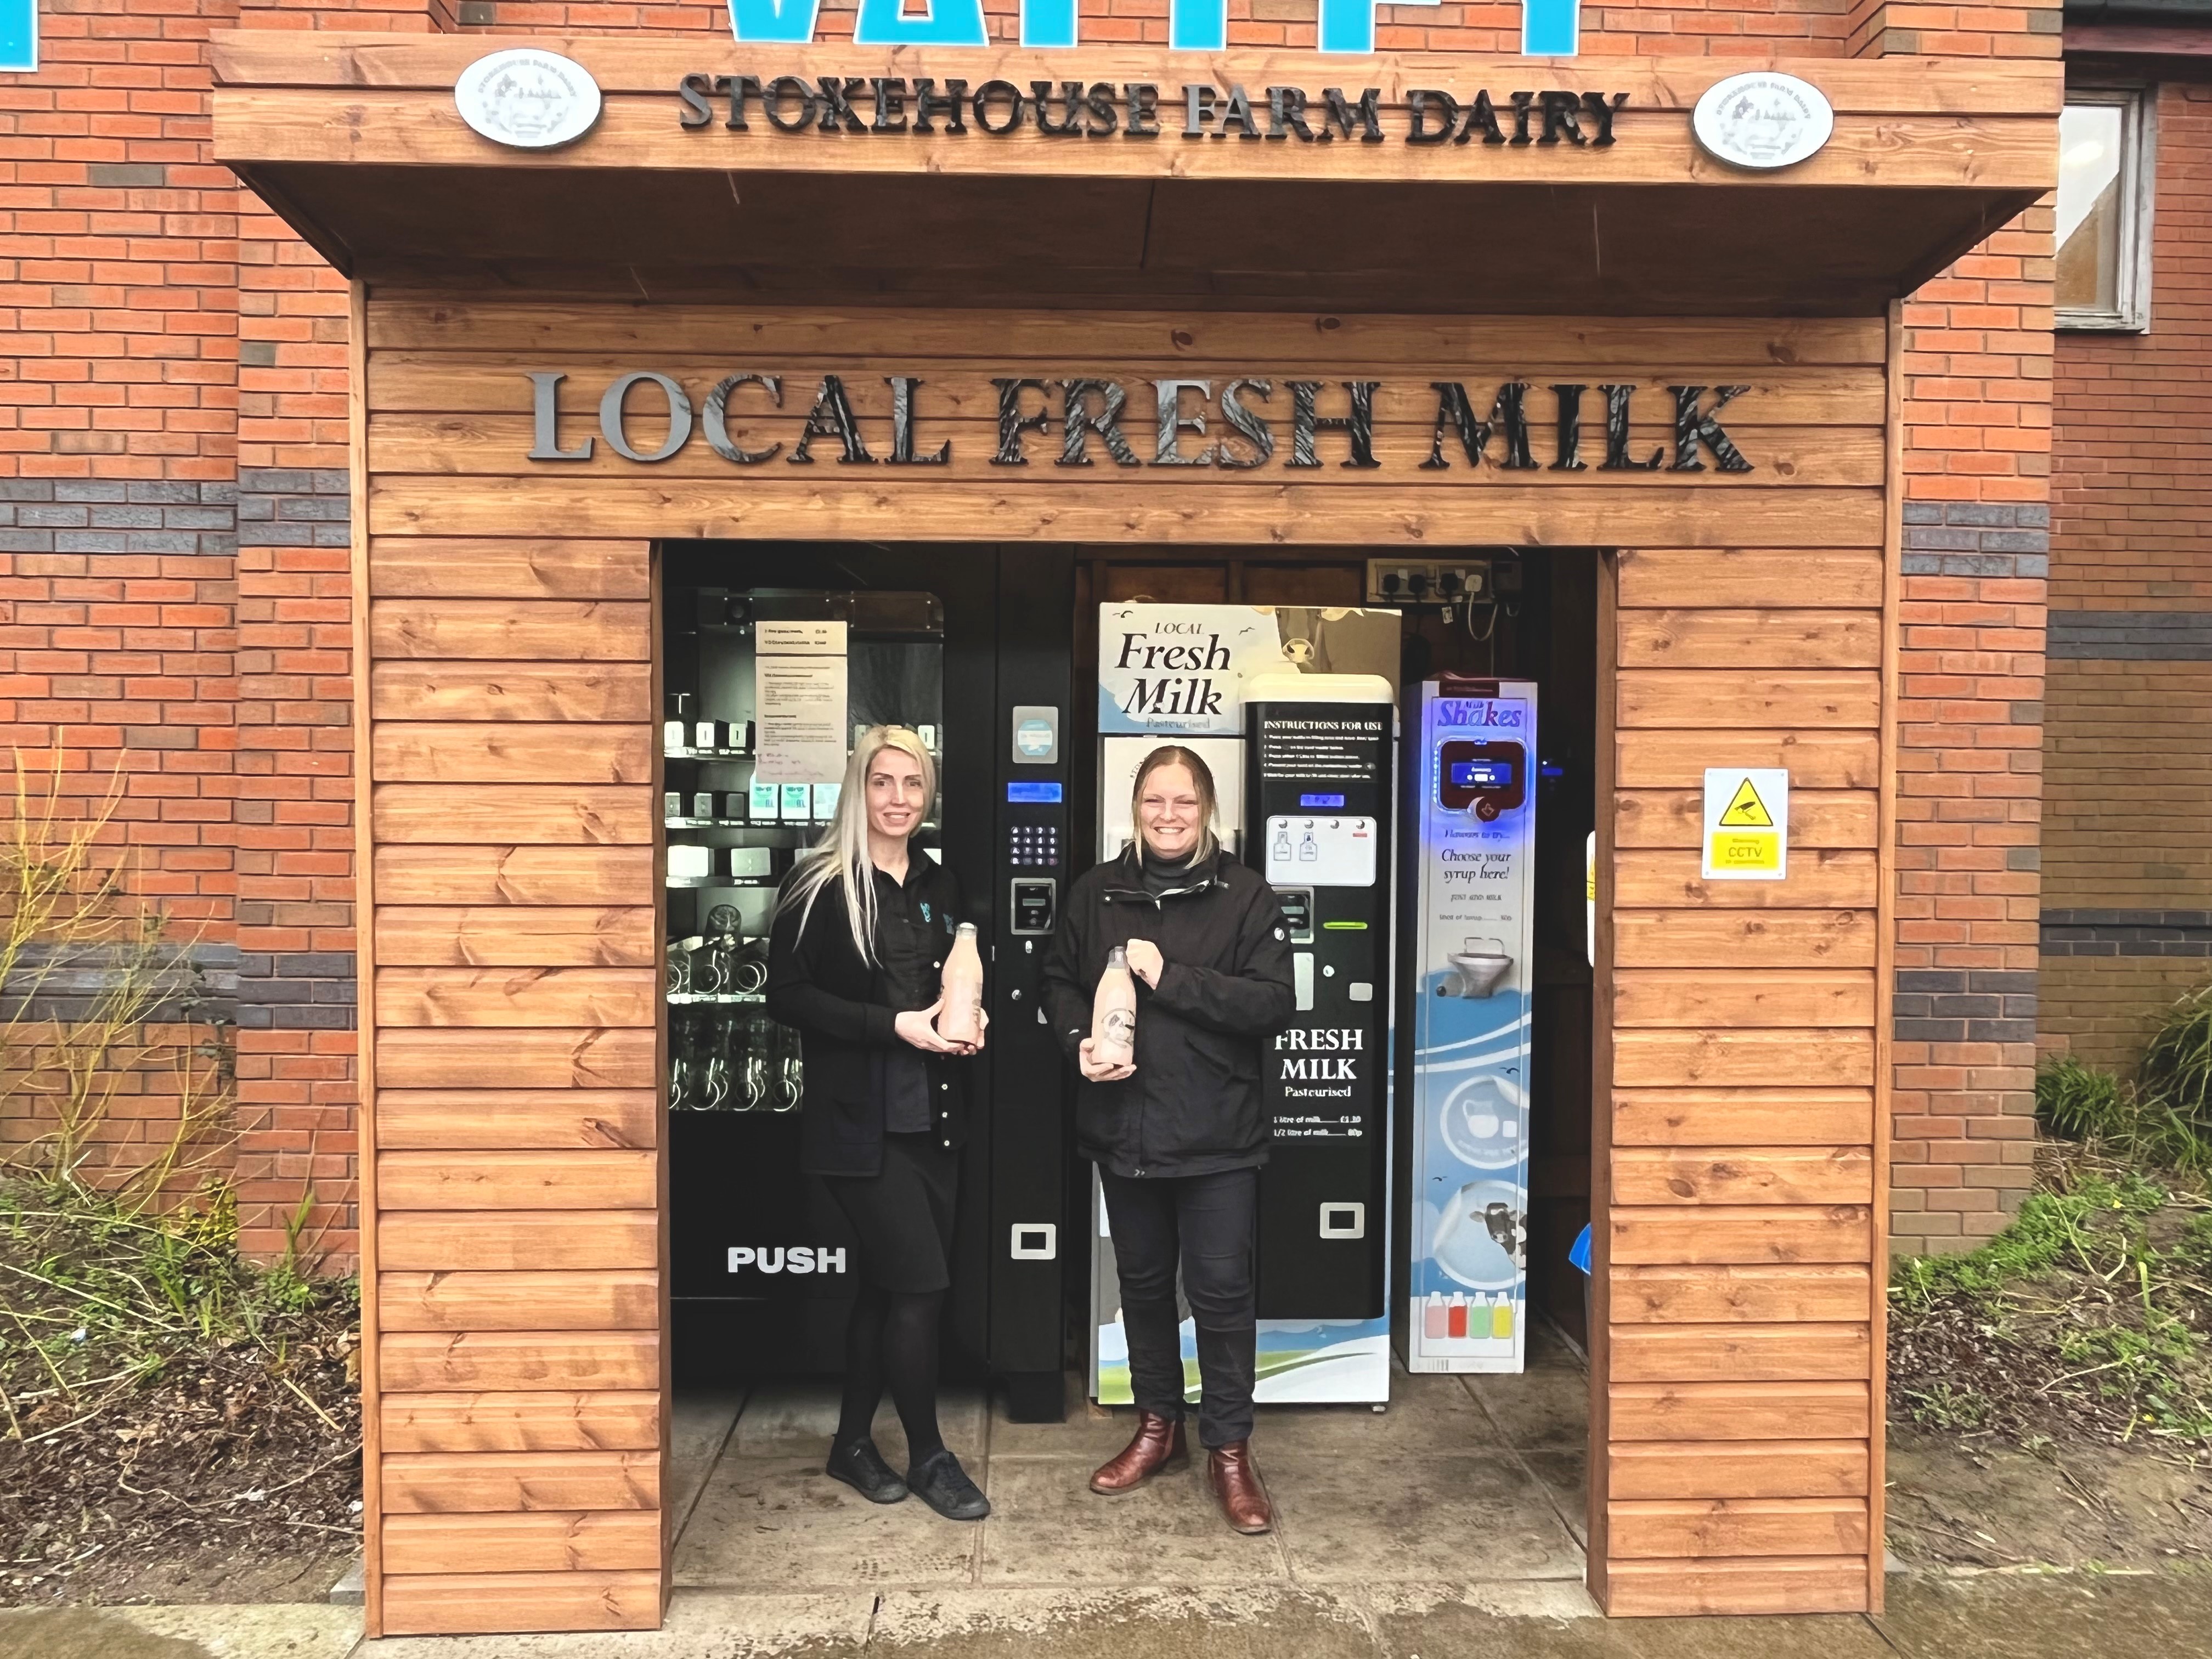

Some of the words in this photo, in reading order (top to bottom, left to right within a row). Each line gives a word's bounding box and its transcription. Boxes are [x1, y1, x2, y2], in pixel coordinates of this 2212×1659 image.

[679, 73, 1159, 137] STOKEHOUSE
[1181, 84, 1386, 142] FARM
[1405, 89, 1630, 145] DAIRY
[526, 371, 951, 466] LOCAL
[988, 376, 1381, 470] FRESH
[1418, 381, 1755, 472] MILK
[1155, 623, 1205, 634] LOCAL
[1114, 633, 1231, 670] Fresh
[1121, 678, 1222, 715] Milk
[1437, 701, 1522, 727] Shakes
[1264, 721, 1339, 730] INSTRUCTIONS
[1341, 721, 1362, 730] FOR
[1364, 721, 1383, 730] USE
[1442, 849, 1481, 861] Choose
[1486, 854, 1511, 864] your
[1728, 847, 1762, 857] CCTV
[1444, 871, 1476, 883] syrup
[1480, 865, 1509, 879] here!
[1274, 1029, 1363, 1050] FRESH
[1280, 1058, 1357, 1080] MILK
[1285, 1086, 1351, 1097] Pasteurised
[728, 1247, 846, 1274] PUSH
